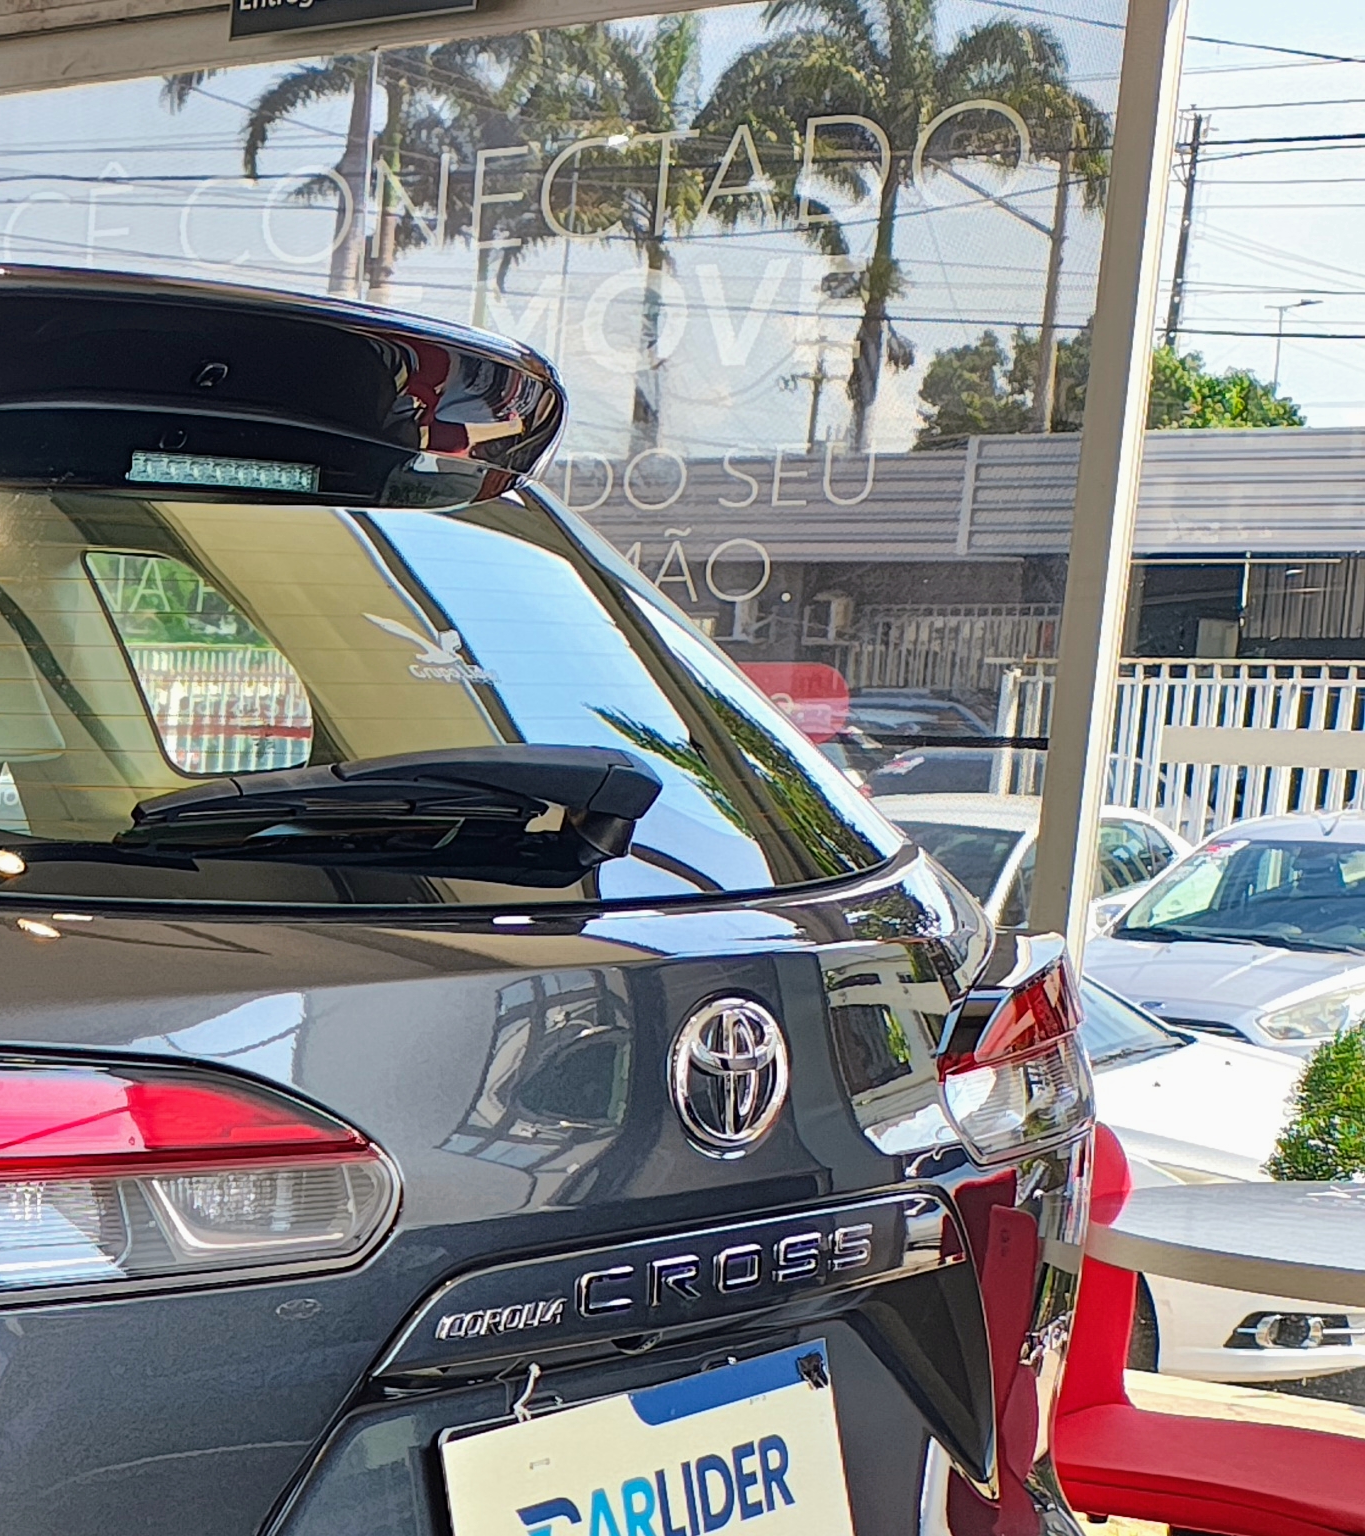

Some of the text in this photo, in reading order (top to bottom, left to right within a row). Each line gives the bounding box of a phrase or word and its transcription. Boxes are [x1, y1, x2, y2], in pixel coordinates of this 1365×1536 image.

[179, 99, 1033, 266] CONECTADO
[563, 440, 875, 514] DO SEU
[435, 1222, 873, 1341] COROLLA CROSS
